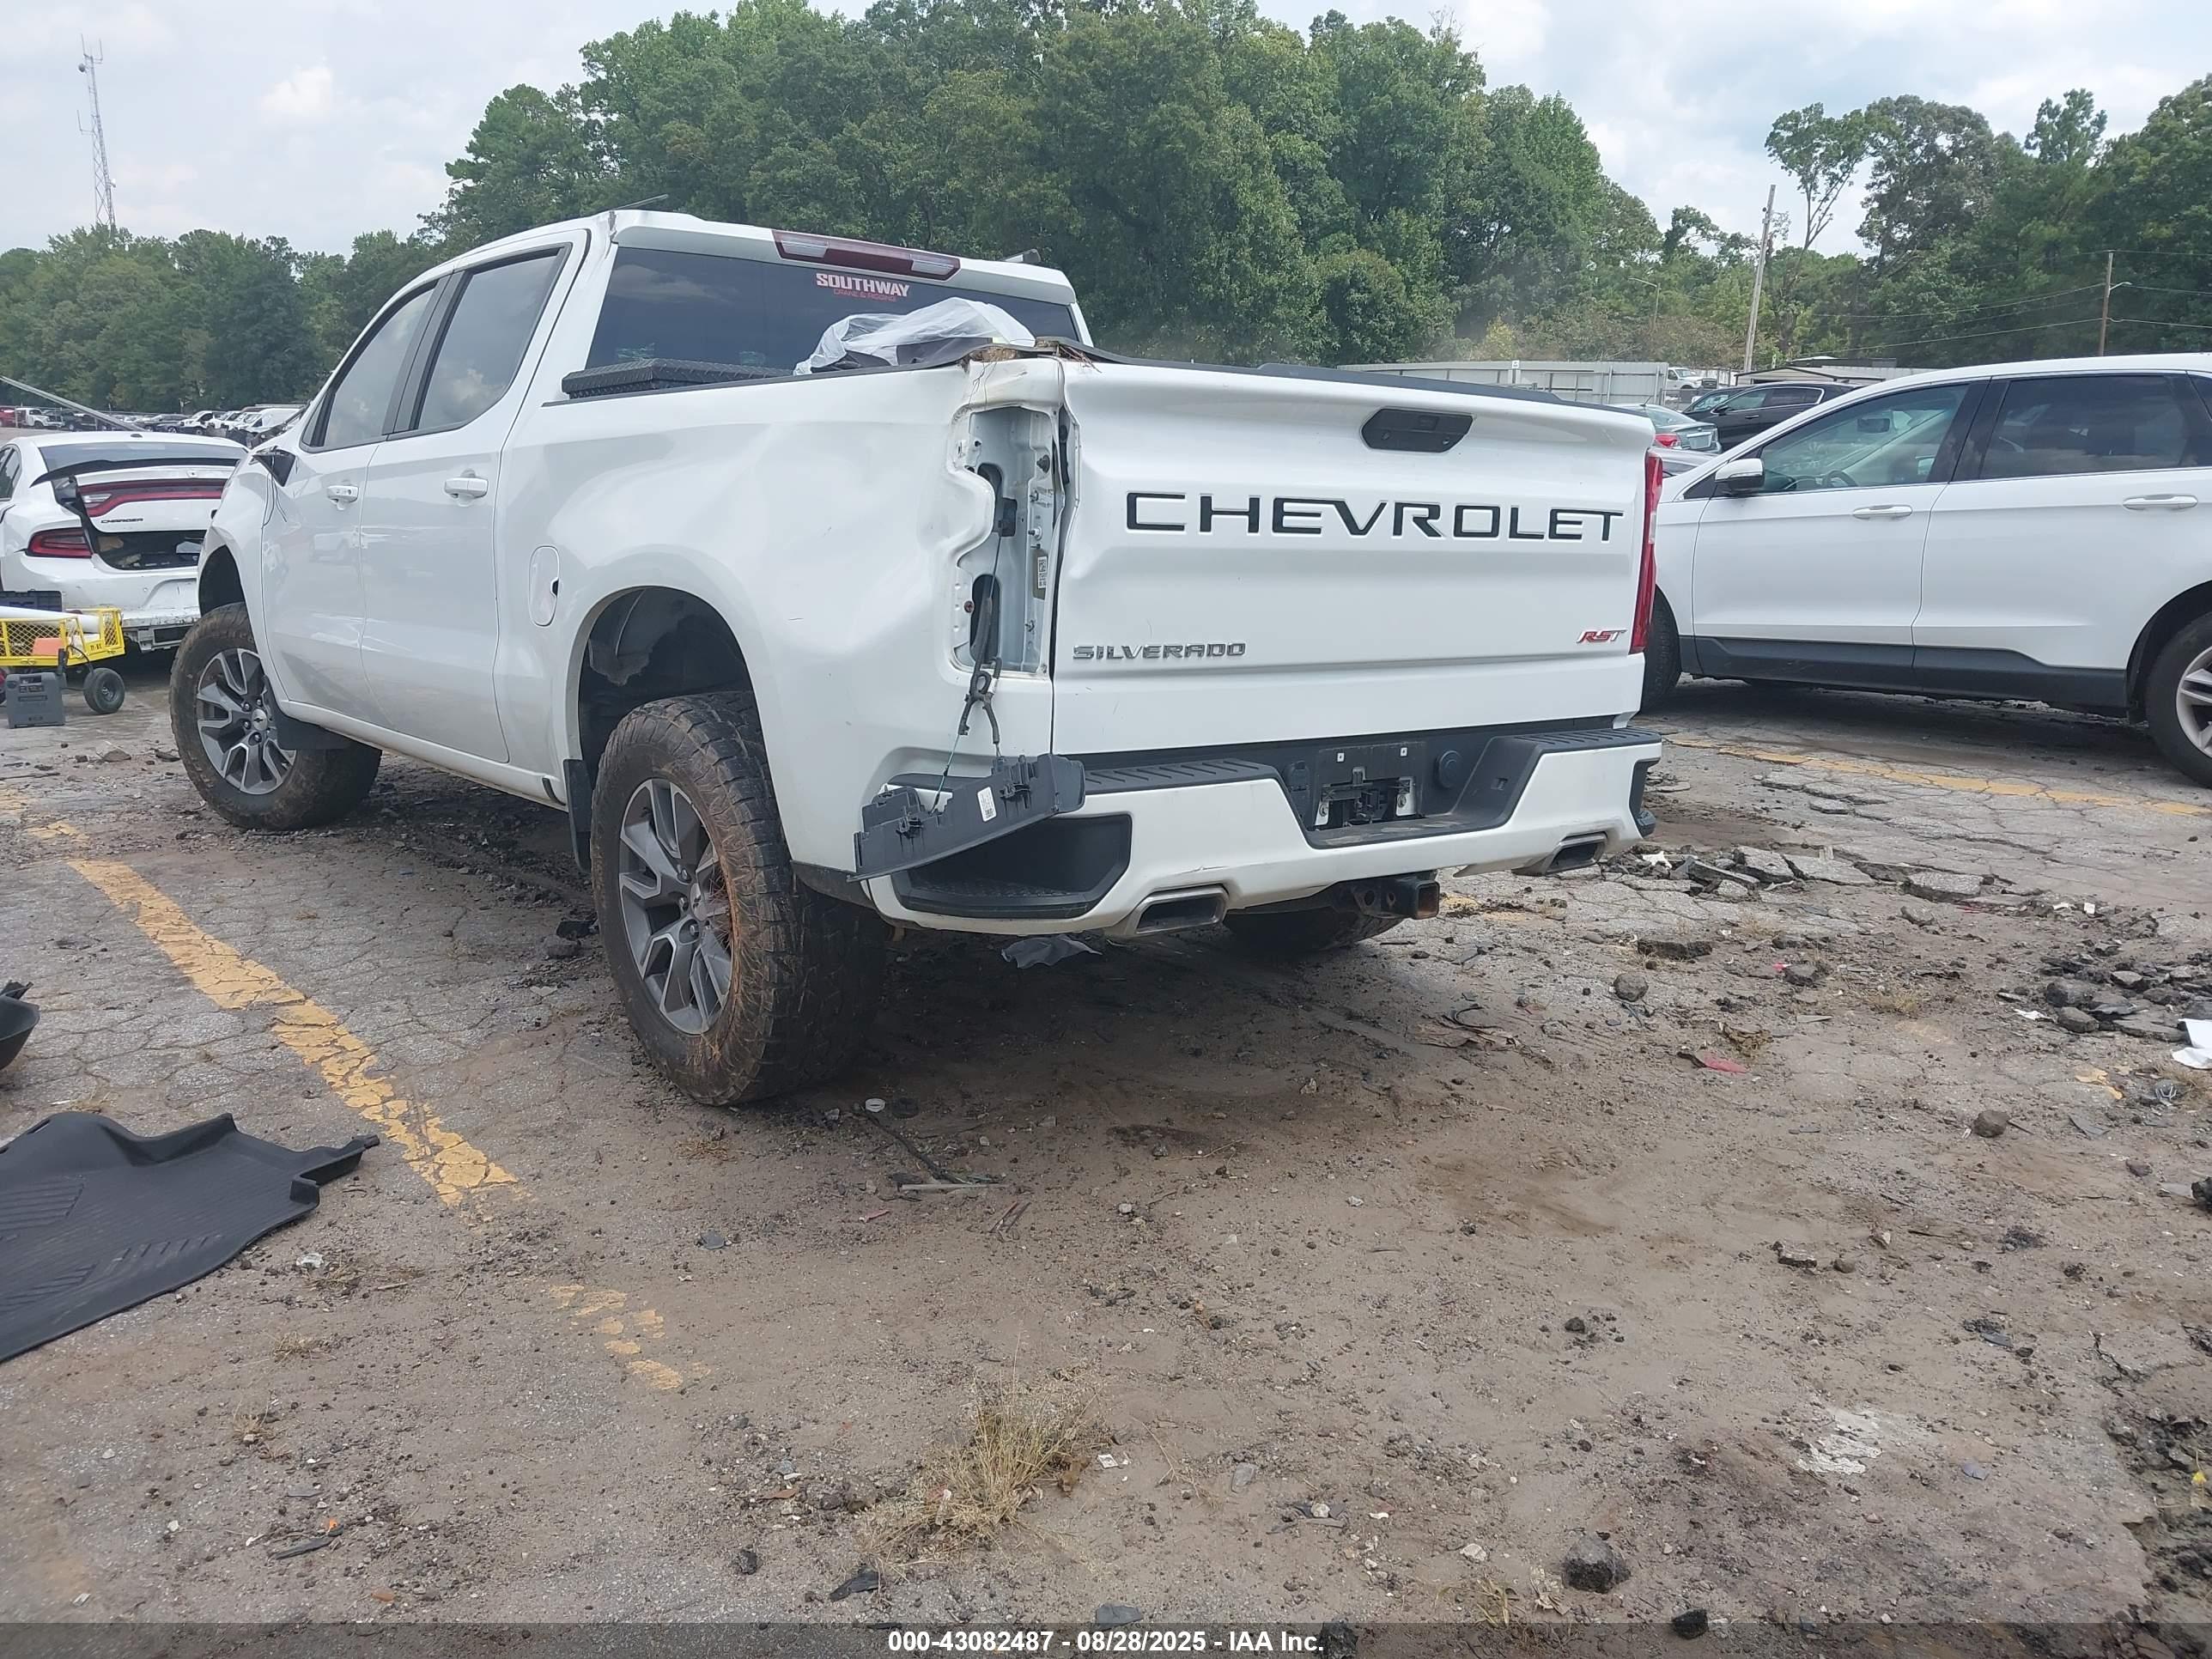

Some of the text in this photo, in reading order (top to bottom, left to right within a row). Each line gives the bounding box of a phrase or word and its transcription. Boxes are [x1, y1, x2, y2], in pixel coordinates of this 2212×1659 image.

[816, 272, 910, 297] SOUTHWAY
[1126, 491, 1625, 543] CHEVROLET
[1575, 629, 1628, 644] RST
[1072, 642, 1246, 660] SILVERADO
